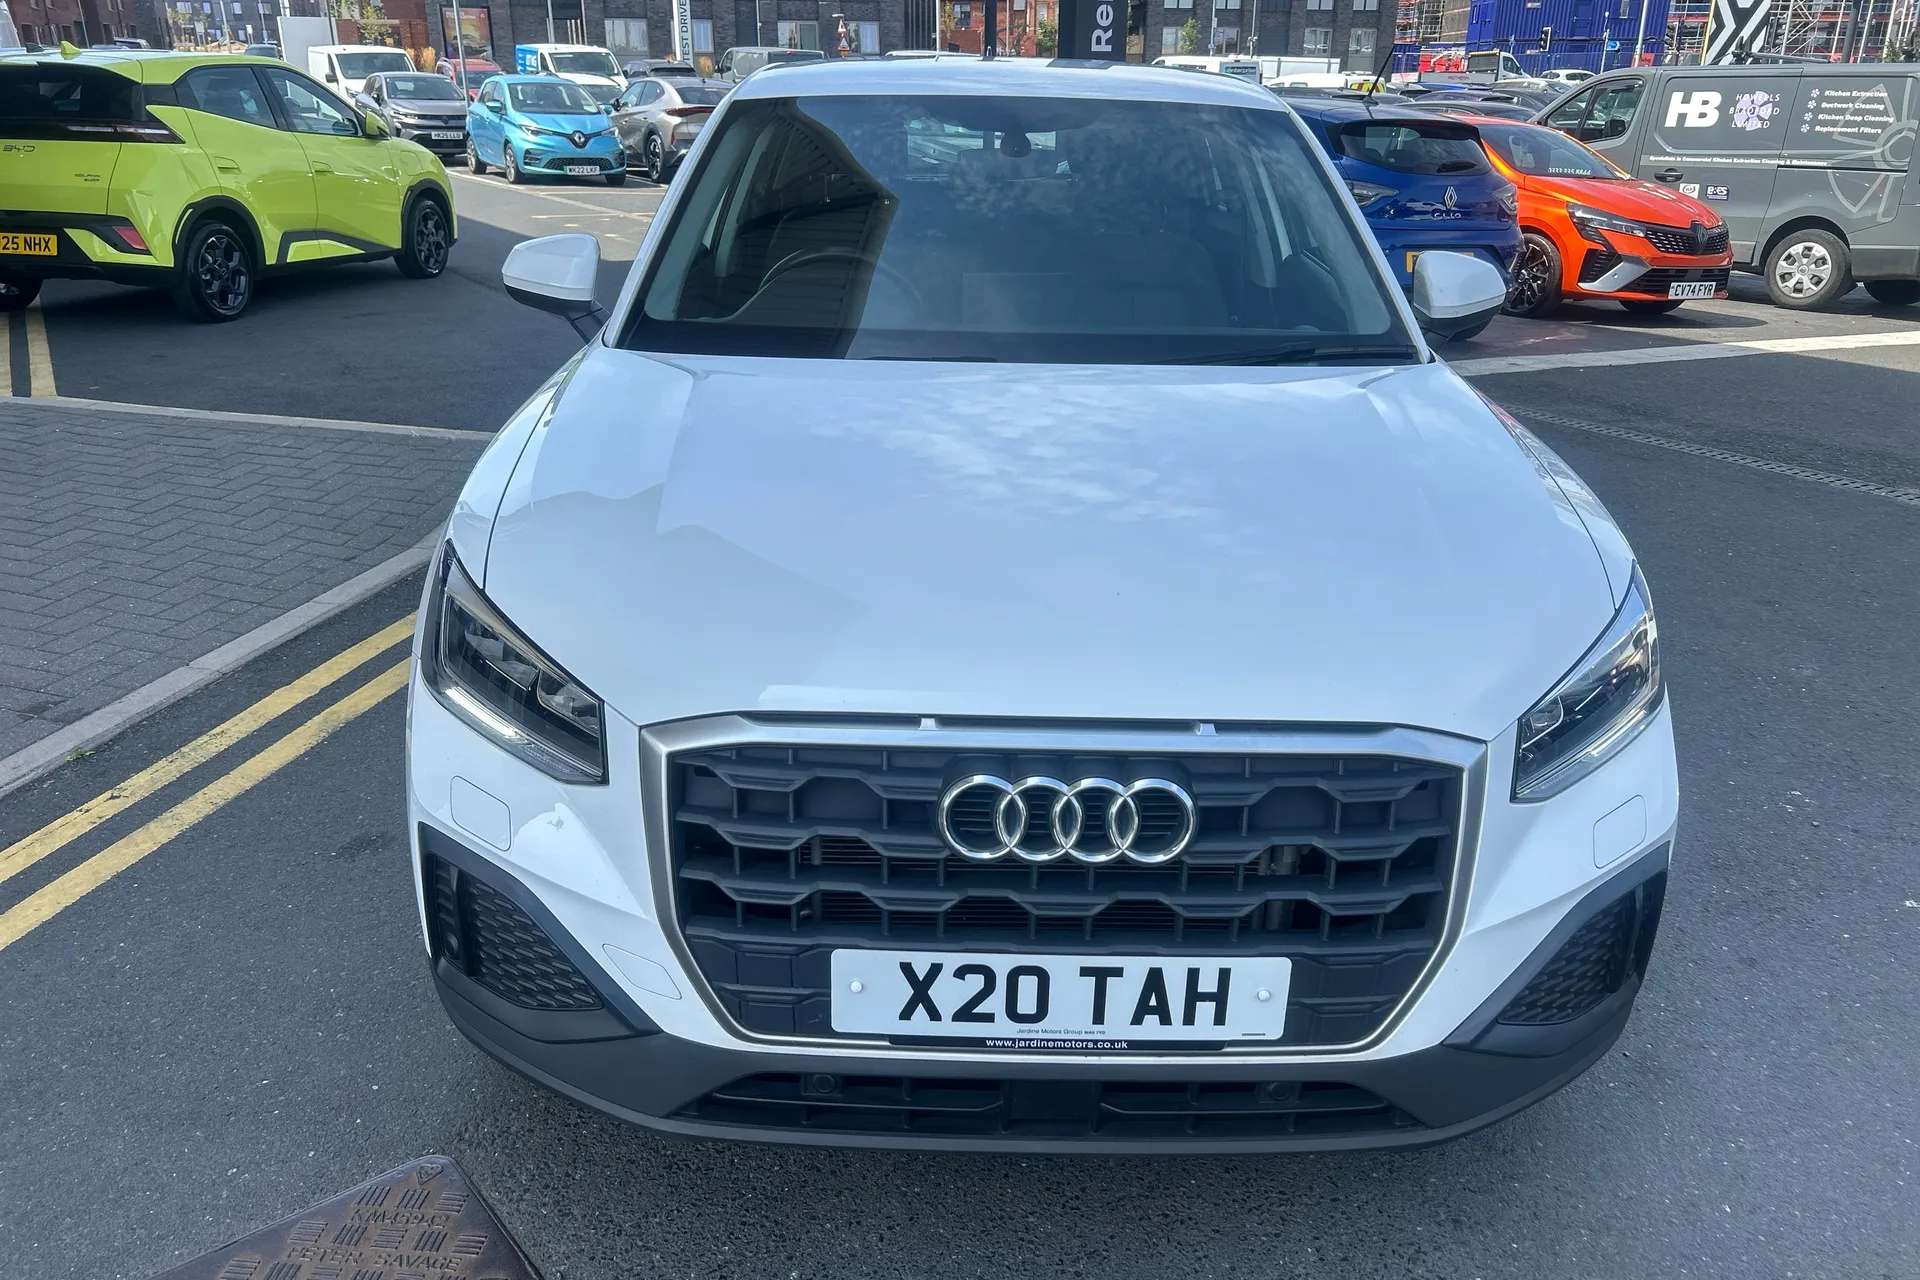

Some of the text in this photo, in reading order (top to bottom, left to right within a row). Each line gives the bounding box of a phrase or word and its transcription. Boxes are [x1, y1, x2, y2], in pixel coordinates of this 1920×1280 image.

[680, 0, 690, 61] TEST DRIVE
[1091, 0, 1113, 51] Re
[1664, 91, 1722, 128] HB
[1864, 115, 1894, 123] Cleaning
[2, 236, 51, 251] 25 NHX
[1675, 284, 1696, 296] CV74
[898, 961, 1232, 1027] X20 TAH
[985, 1038, 1128, 1049] www.jardinemotors.co.uk
[287, 1246, 462, 1273] PETER SAVAGE
